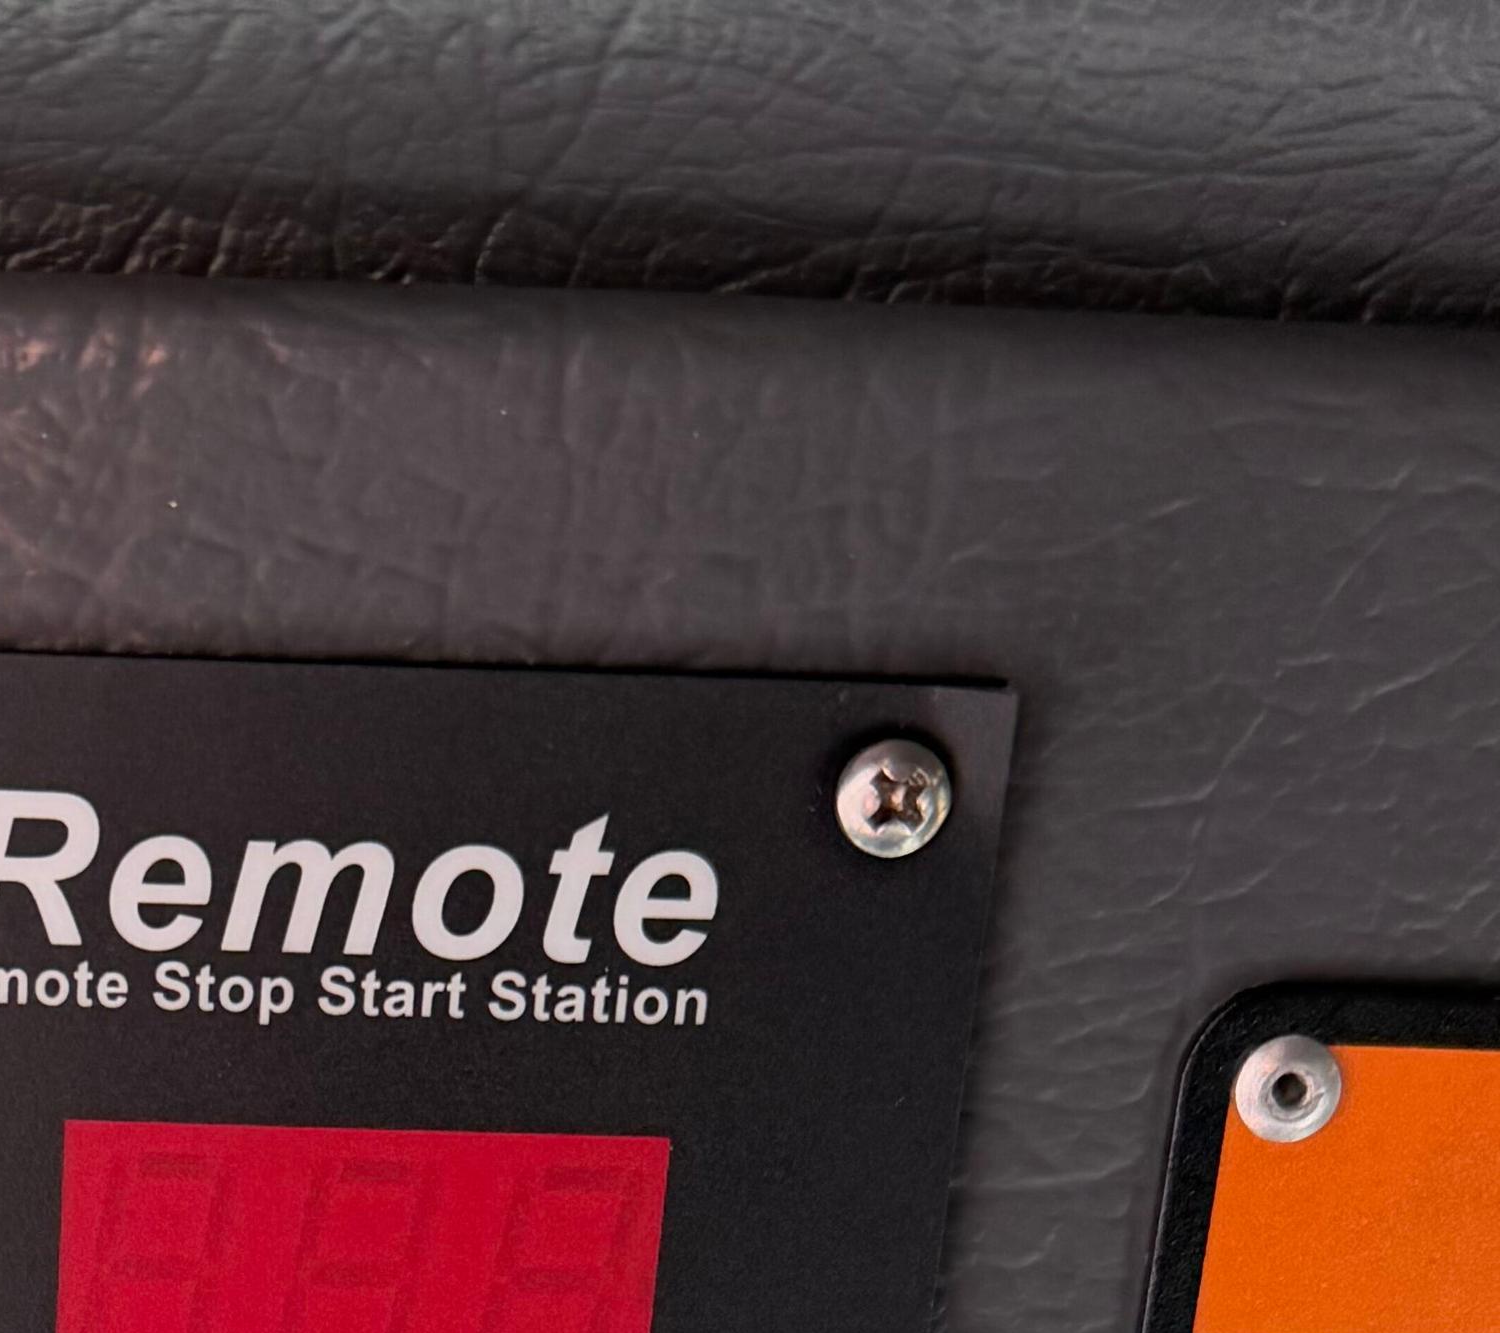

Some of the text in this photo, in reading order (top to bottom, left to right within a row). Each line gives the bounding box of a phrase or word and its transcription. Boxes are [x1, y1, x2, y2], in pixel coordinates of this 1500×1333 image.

[152, 960, 294, 1026] Stop
[318, 965, 467, 1019] Start
[488, 968, 708, 1026] Station
